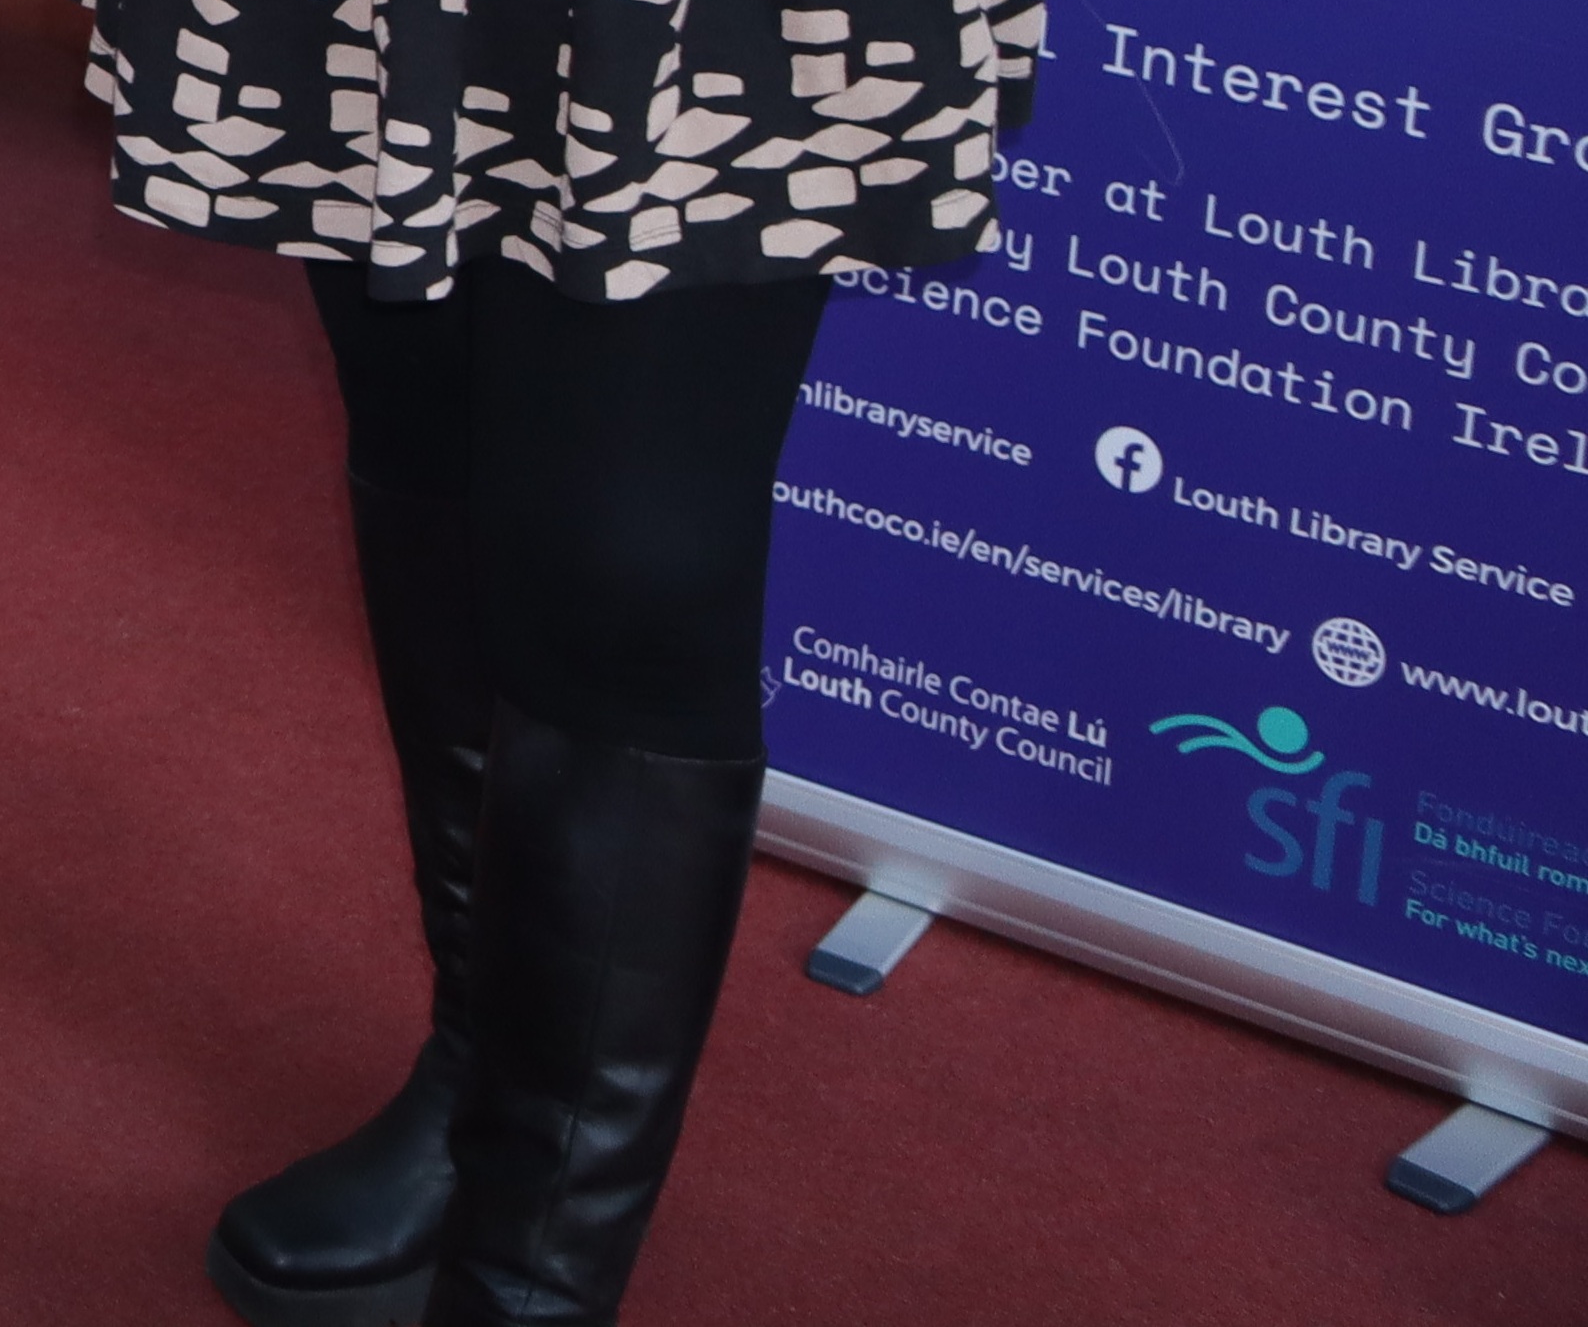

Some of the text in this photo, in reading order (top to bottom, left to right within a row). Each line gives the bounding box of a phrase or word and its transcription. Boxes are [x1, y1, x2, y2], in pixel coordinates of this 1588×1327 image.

[1102, 22, 1432, 142] Interest
[1068, 233, 1229, 313] Louth
[1264, 282, 1477, 382] County
[1104, 177, 1588, 320] at Louth Libra
[1076, 310, 1415, 432] Foundation
[1173, 475, 1575, 607] Louth Library Service
[783, 657, 1113, 788] Louth County Council
[792, 625, 1108, 748] Comhairle Contae Lú
[1414, 821, 1448, 850] Dá
[1455, 834, 1530, 877] bhfuil
[1405, 898, 1450, 927] For
[1456, 918, 1539, 960] what's
